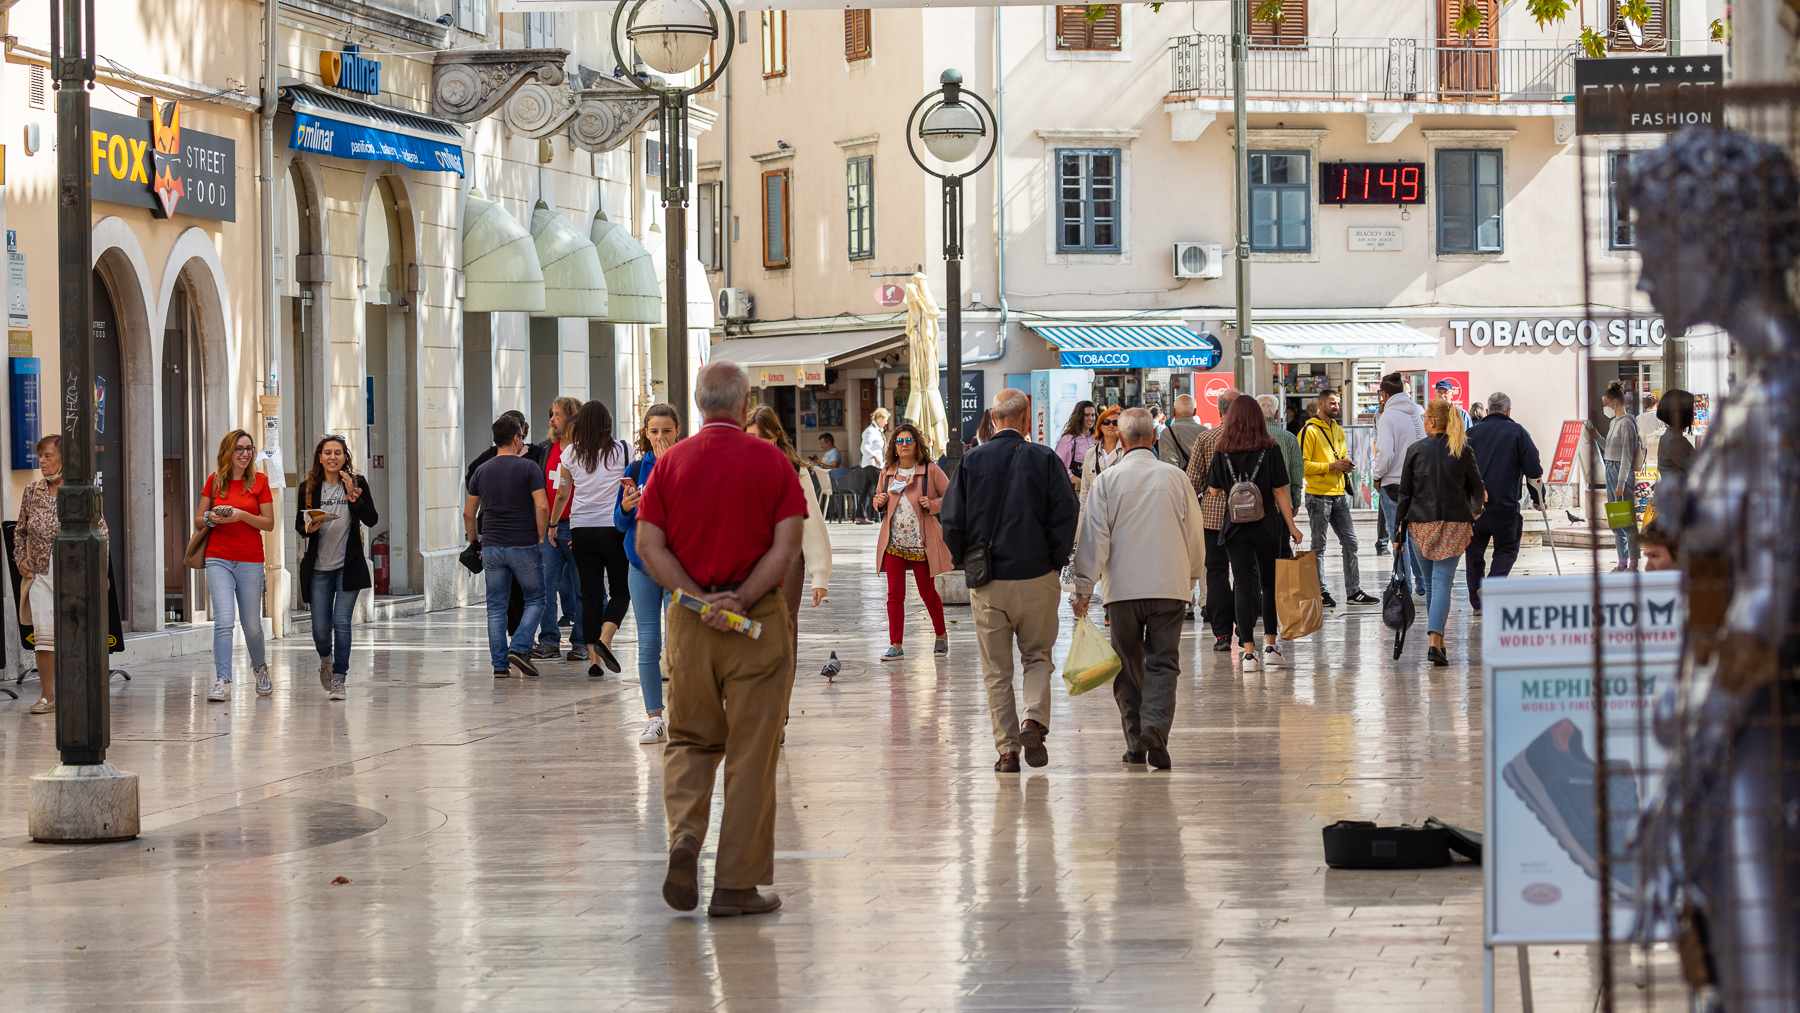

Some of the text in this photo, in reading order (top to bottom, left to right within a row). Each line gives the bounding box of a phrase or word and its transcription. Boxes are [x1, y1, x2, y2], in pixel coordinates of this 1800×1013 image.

[343, 45, 381, 95] mlinar
[1631, 112, 1712, 126] FASHION
[303, 122, 334, 152] mlinar
[91, 130, 149, 184] FOX
[186, 145, 226, 175] STREET
[187, 178, 227, 207] FOOD
[1449, 319, 1667, 347] TOBACCO SHO
[1078, 353, 1130, 364] TOBACCO
[1167, 354, 1208, 367] iNovine
[1500, 634, 1556, 647] WORLD'S
[1562, 633, 1597, 645] FINES
